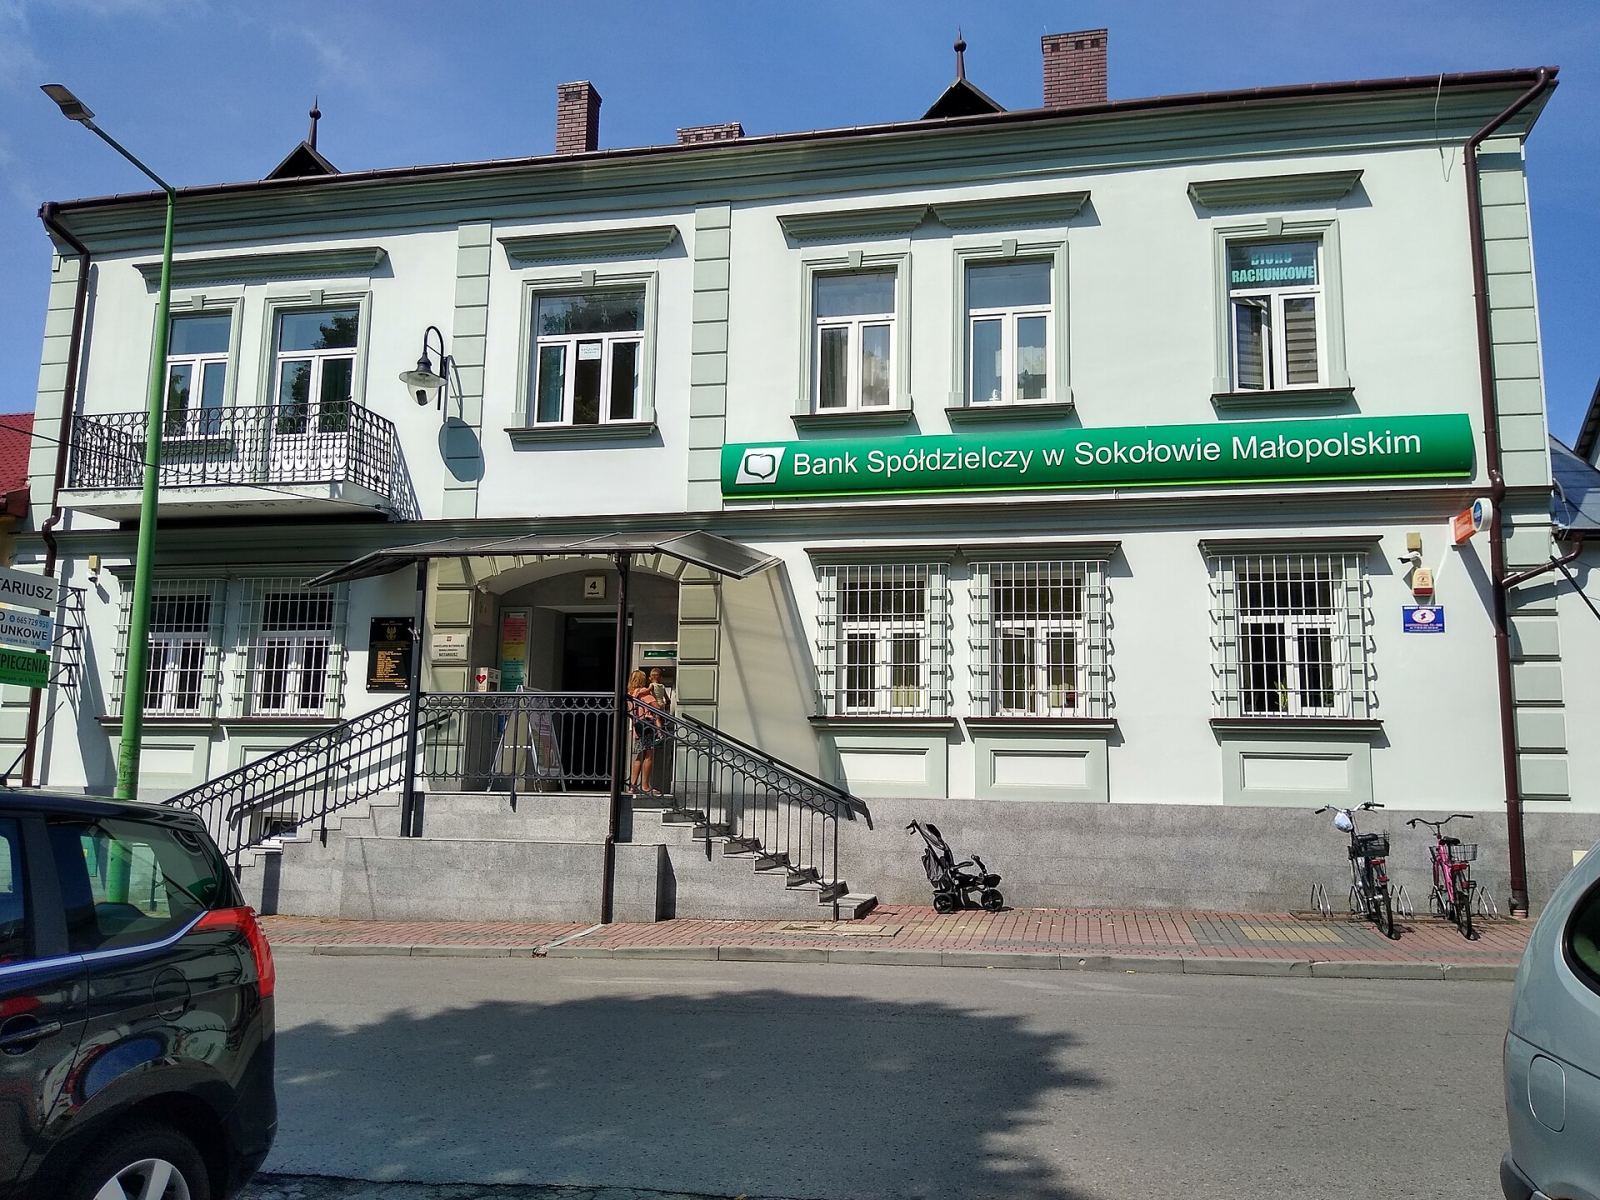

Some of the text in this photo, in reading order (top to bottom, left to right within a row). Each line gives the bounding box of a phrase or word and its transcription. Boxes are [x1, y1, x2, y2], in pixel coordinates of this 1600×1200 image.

[1231, 265, 1314, 283] RACHUNKOWE
[793, 429, 1421, 478] Bank Spółdzielczy w Sokołowie Małopolskim
[0, 578, 53, 600] ARIUSZ
[590, 581, 598, 590] 4
[0, 624, 48, 641] UNKOWE
